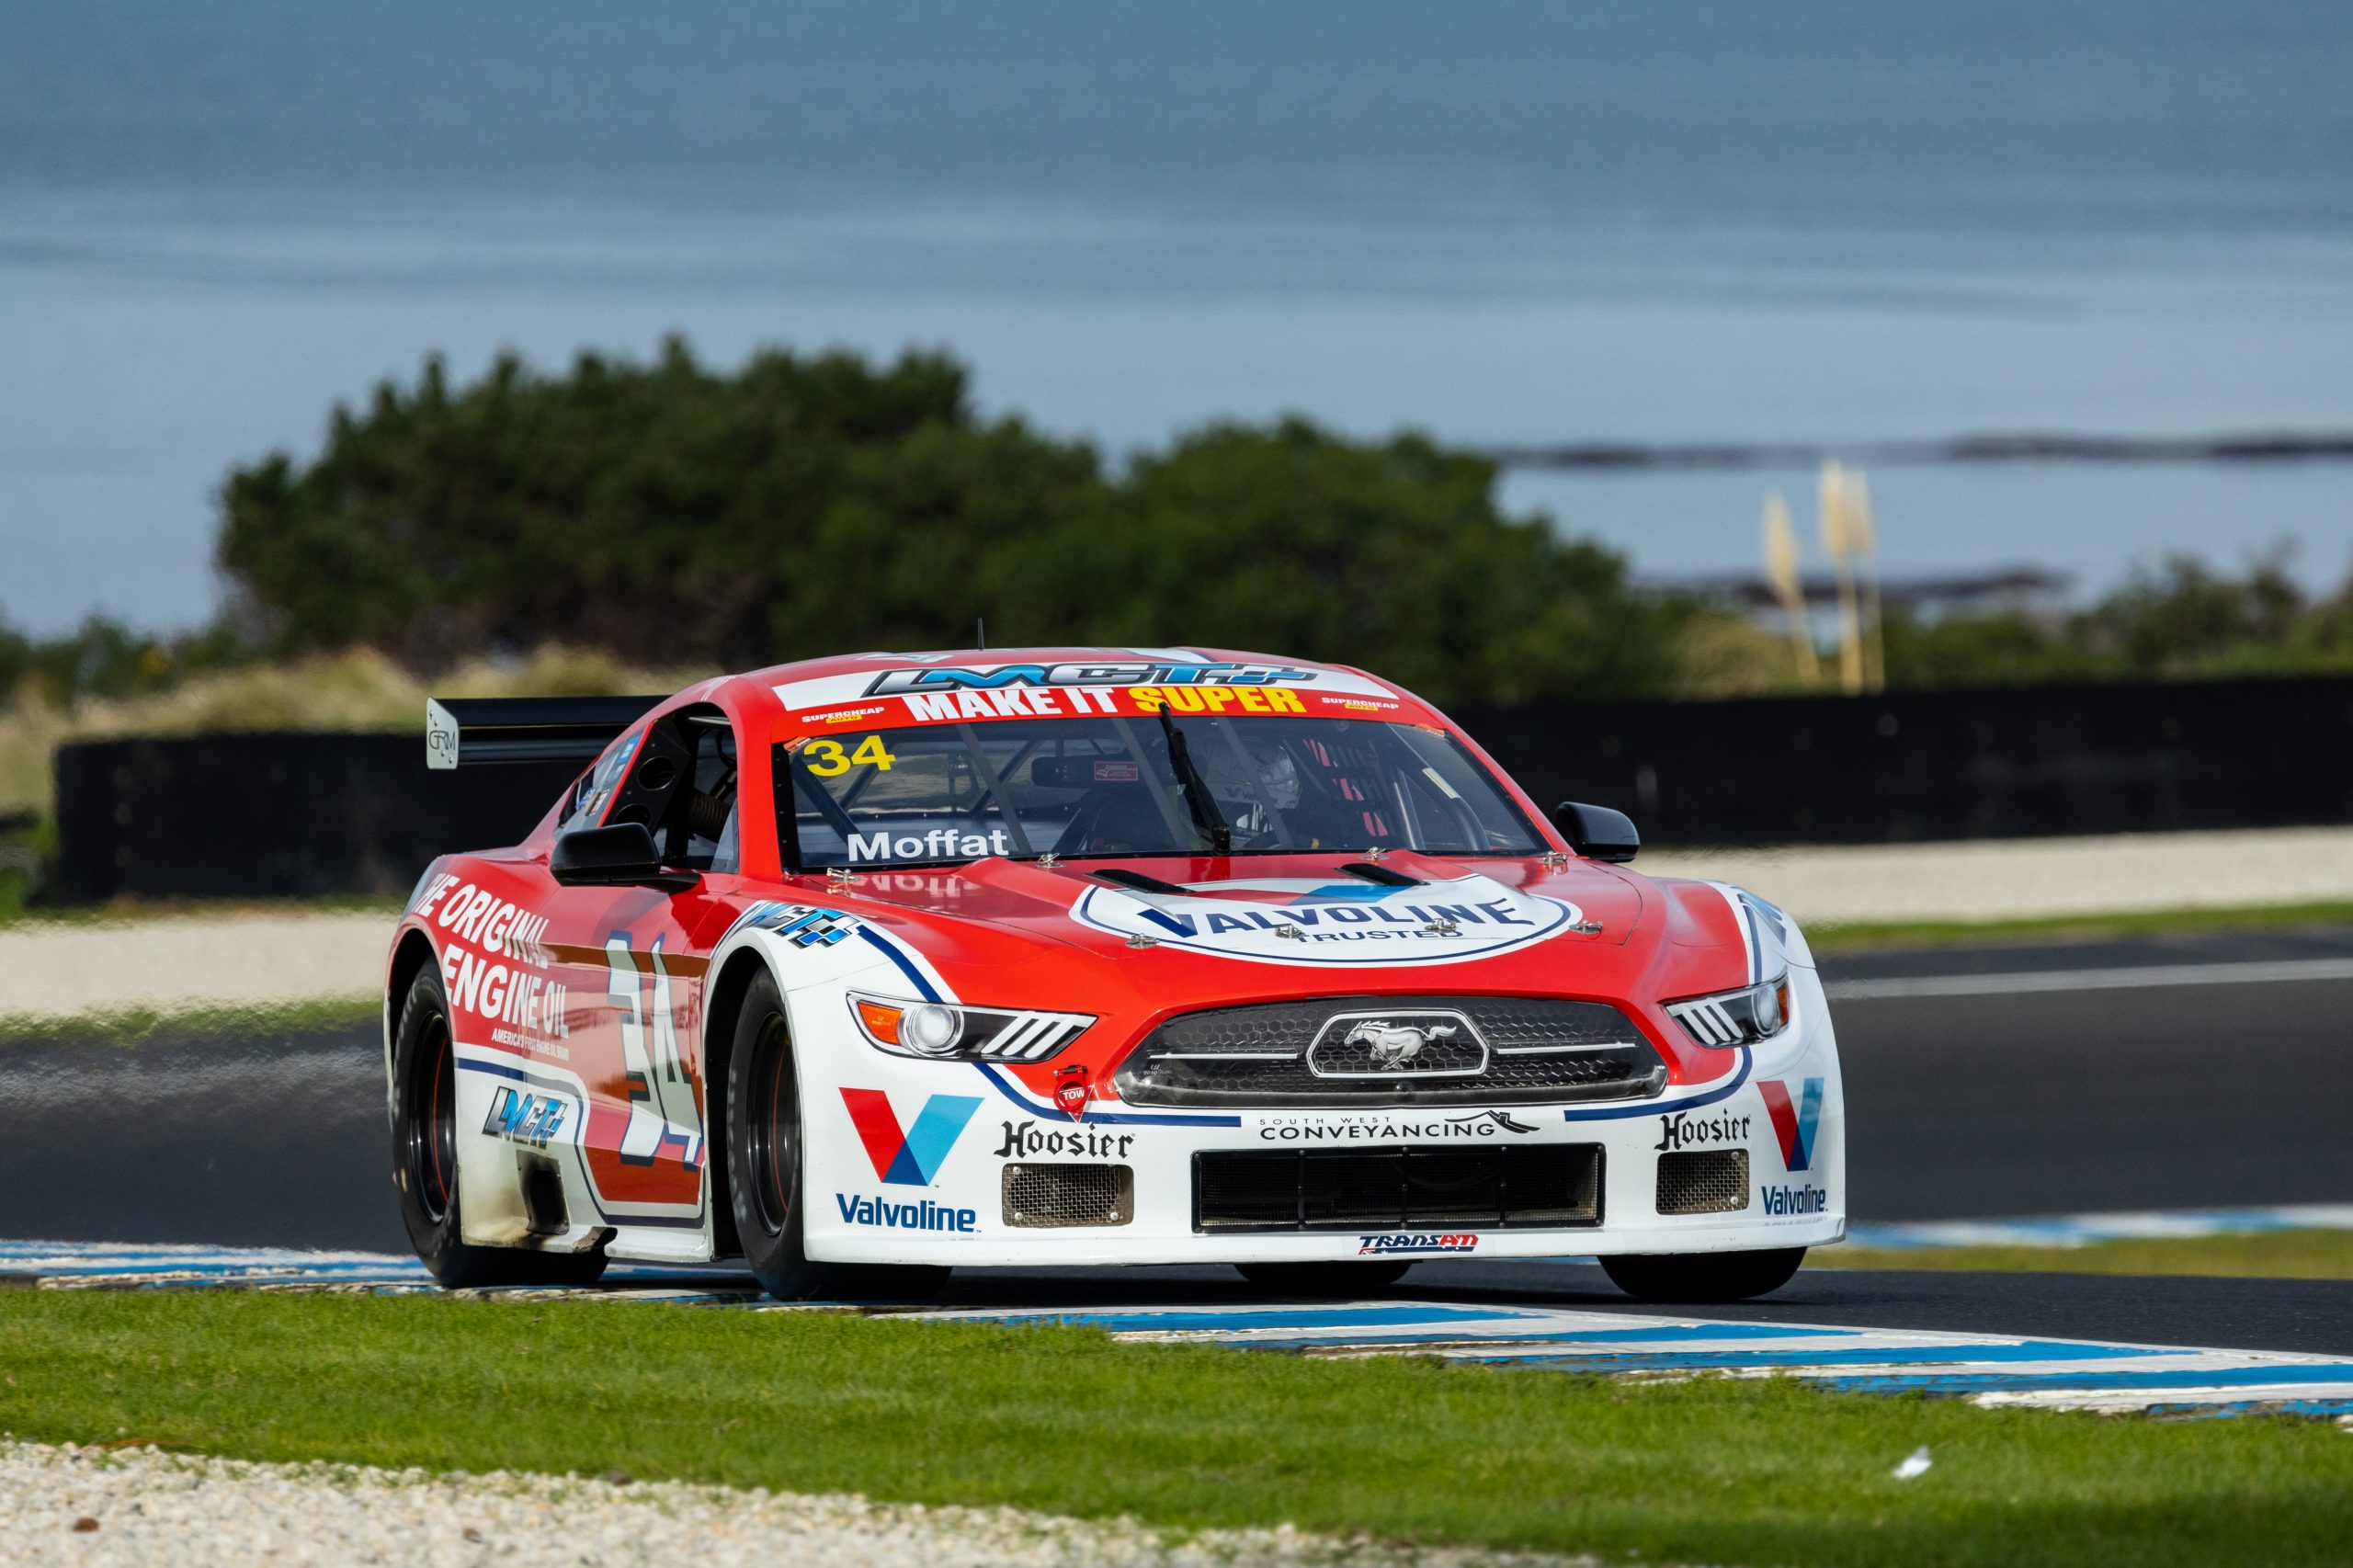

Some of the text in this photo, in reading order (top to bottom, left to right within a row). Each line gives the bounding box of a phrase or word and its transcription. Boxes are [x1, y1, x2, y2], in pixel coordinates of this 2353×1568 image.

[801, 706, 885, 723] SUPERCHEAP
[830, 714, 860, 722] AUTO
[902, 687, 1308, 722] MAKE IT SUPER
[1321, 697, 1399, 710] SUPERCHEAP
[428, 730, 456, 751] GRM
[803, 734, 896, 778] 34
[847, 829, 1009, 862] Moffat
[411, 873, 550, 970] HE ORIGINAL
[1137, 897, 1536, 938] VALVOLINE
[1297, 929, 1463, 943] TRUSTED
[442, 943, 570, 1039] ENGINE OIL
[491, 1028, 524, 1049] AMERICA'S
[604, 929, 703, 1168] 34
[1063, 1088, 1085, 1100] TOW
[1259, 1118, 1324, 1126] SOUTH
[1260, 1123, 1495, 1141] CONVEYANCING
[1654, 1108, 1751, 1151] Hoosier
[994, 1119, 1134, 1159] Hoosier
[835, 1193, 976, 1233] Valvoline
[1761, 1184, 1826, 1215] Valvoline
